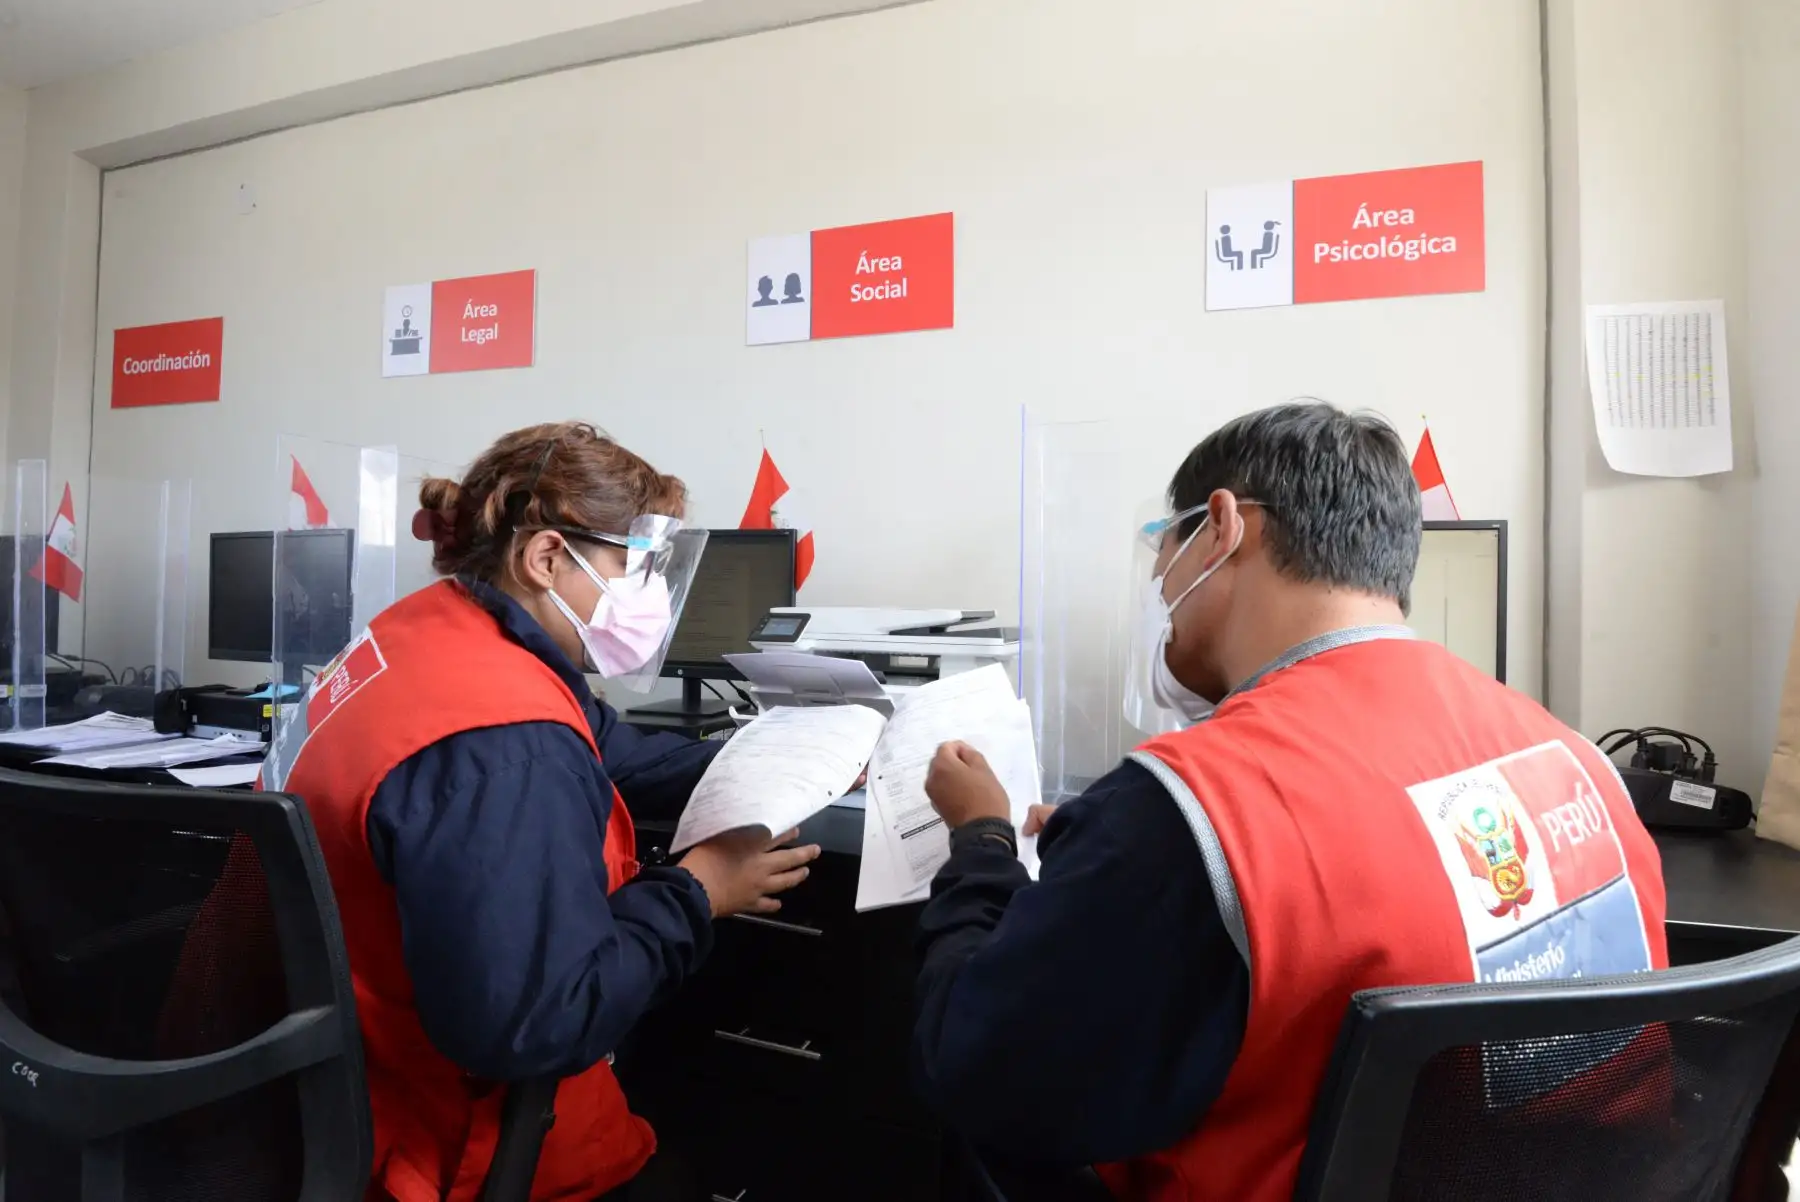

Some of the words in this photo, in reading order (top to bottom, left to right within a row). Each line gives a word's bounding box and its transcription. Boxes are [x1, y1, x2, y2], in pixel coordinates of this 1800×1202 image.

[1352, 202, 1415, 230] Área
[1313, 232, 1457, 264] Psicológica
[855, 250, 903, 275] Área
[850, 277, 908, 303] Social
[462, 298, 498, 320] Área
[461, 322, 499, 345] Legal
[122, 349, 211, 375] Coordinación
[1540, 781, 1602, 853] PERÚ
